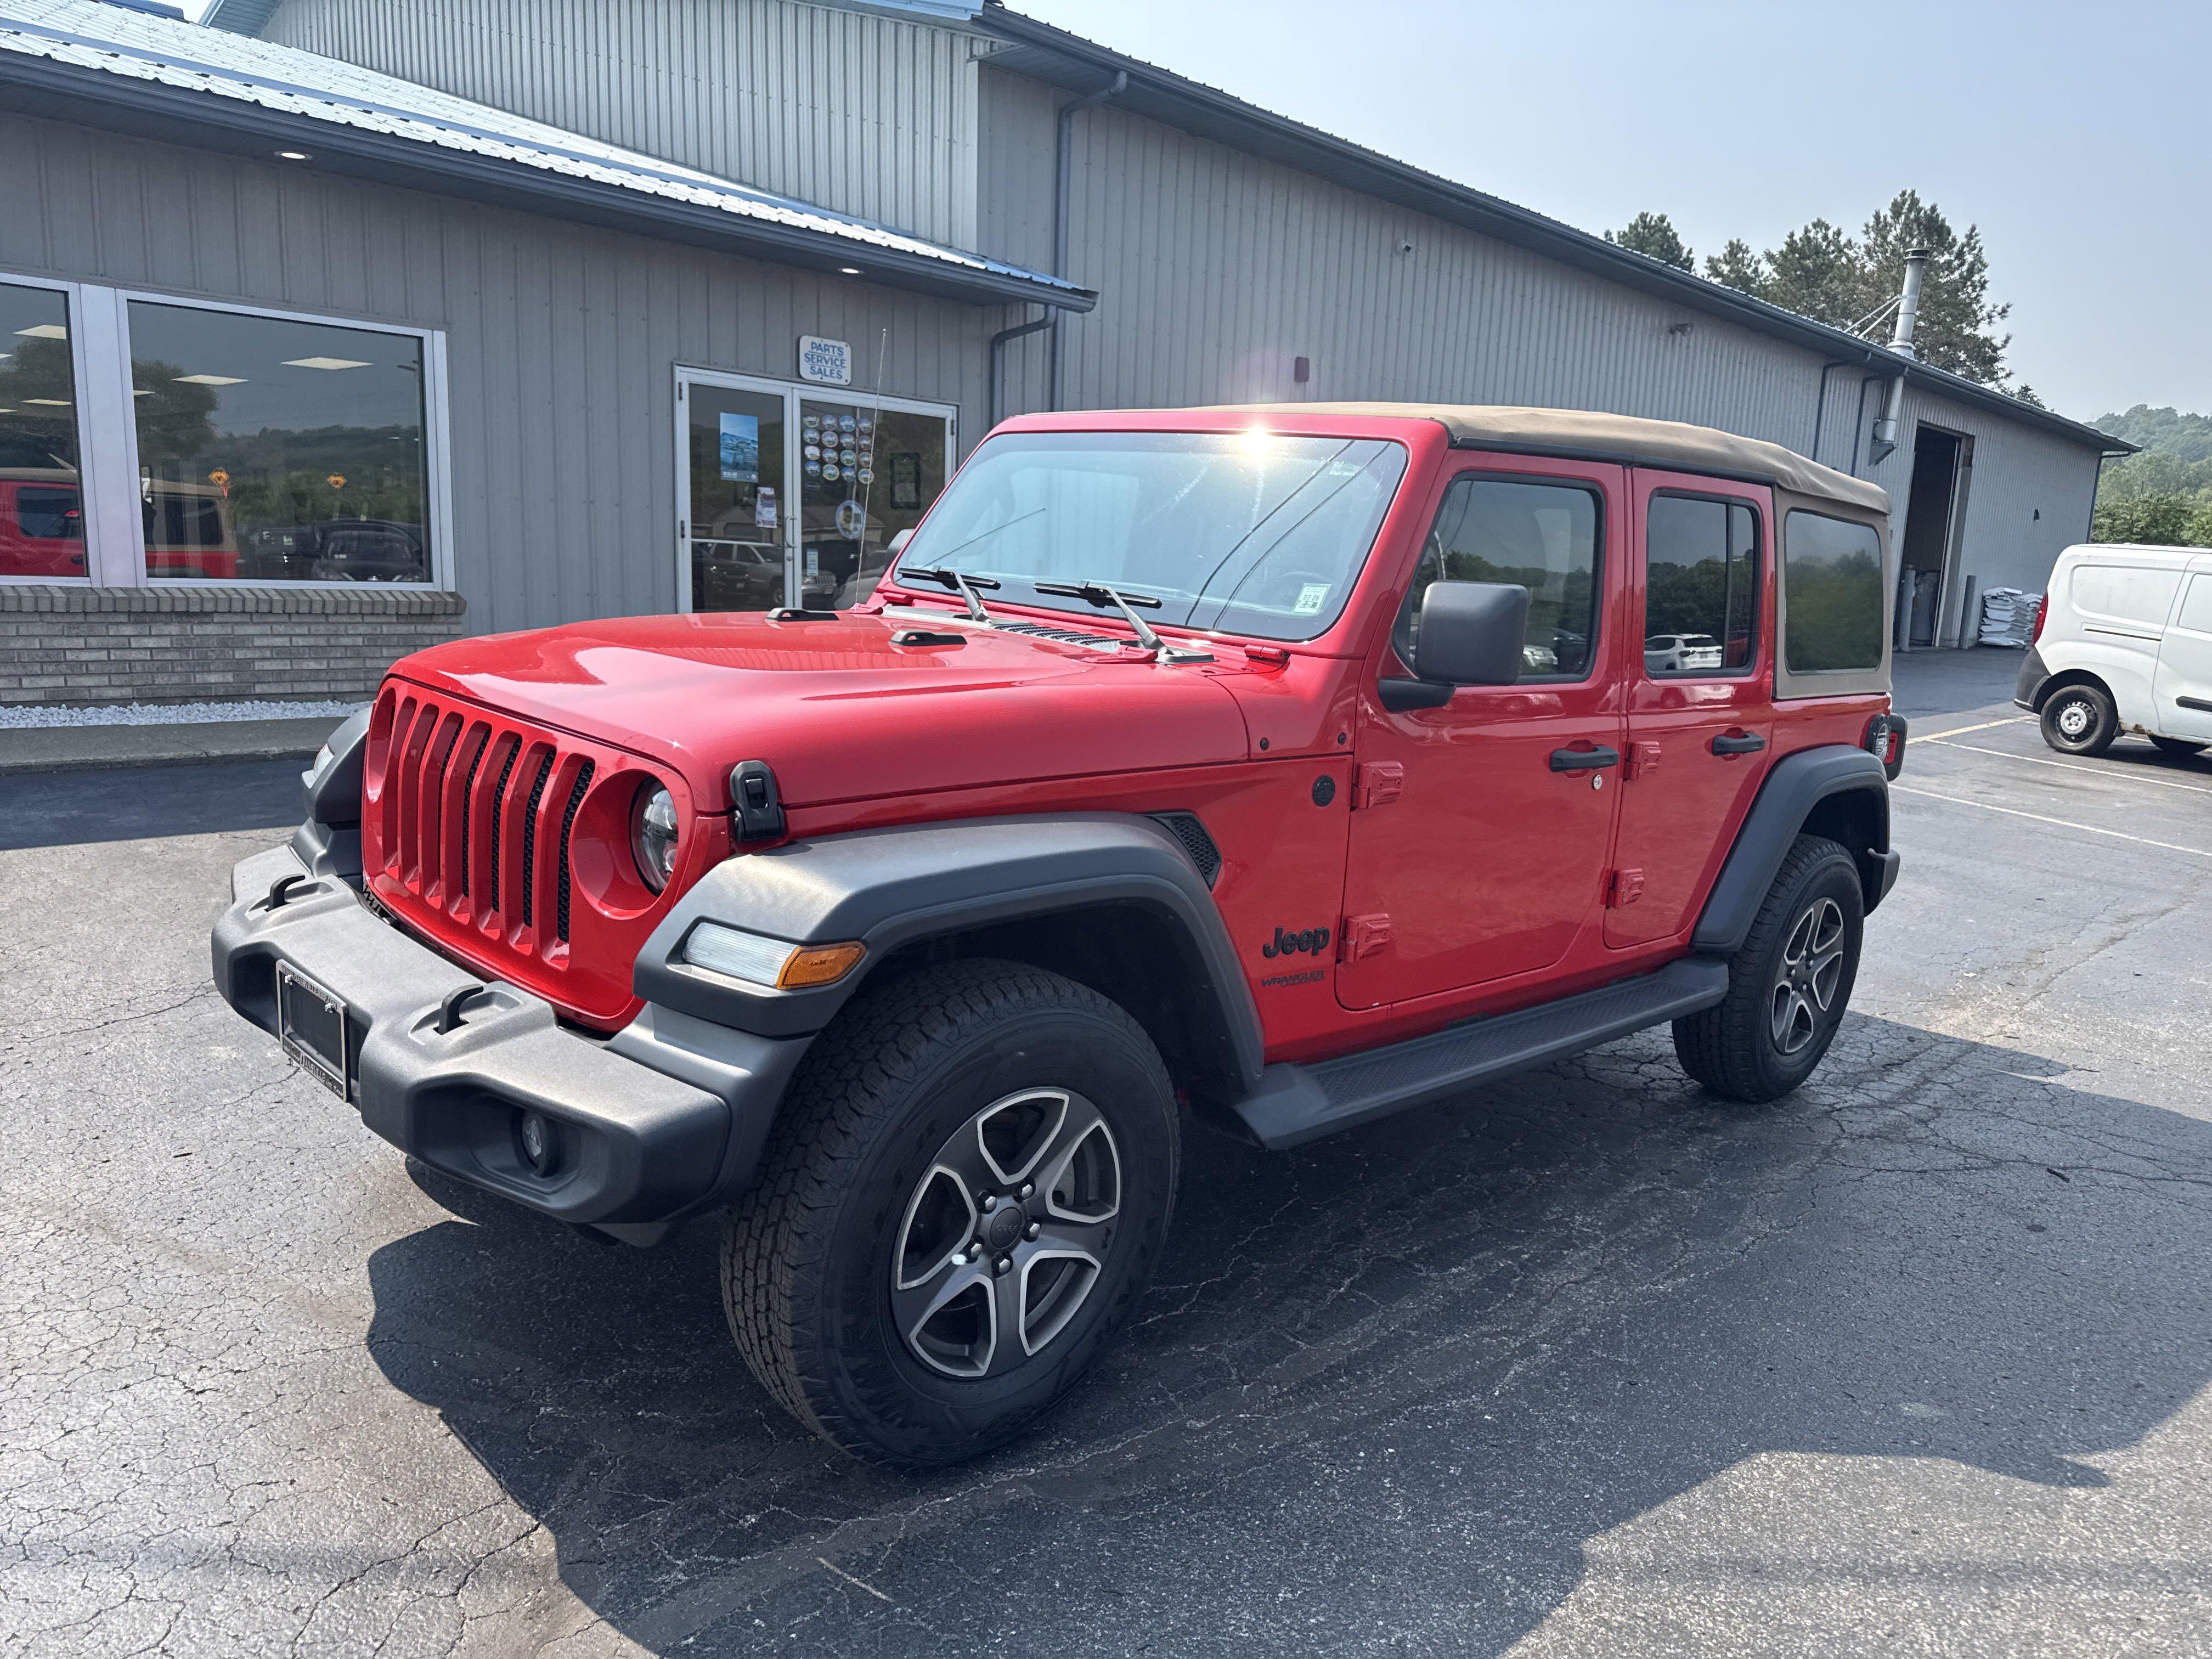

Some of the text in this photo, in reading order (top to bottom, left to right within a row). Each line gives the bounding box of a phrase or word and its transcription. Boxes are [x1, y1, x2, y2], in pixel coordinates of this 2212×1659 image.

[811, 341, 844, 357] PARTS
[804, 353, 847, 369] SERVICE
[810, 366, 843, 380] SALES
[1263, 926, 1330, 958] Jeep
